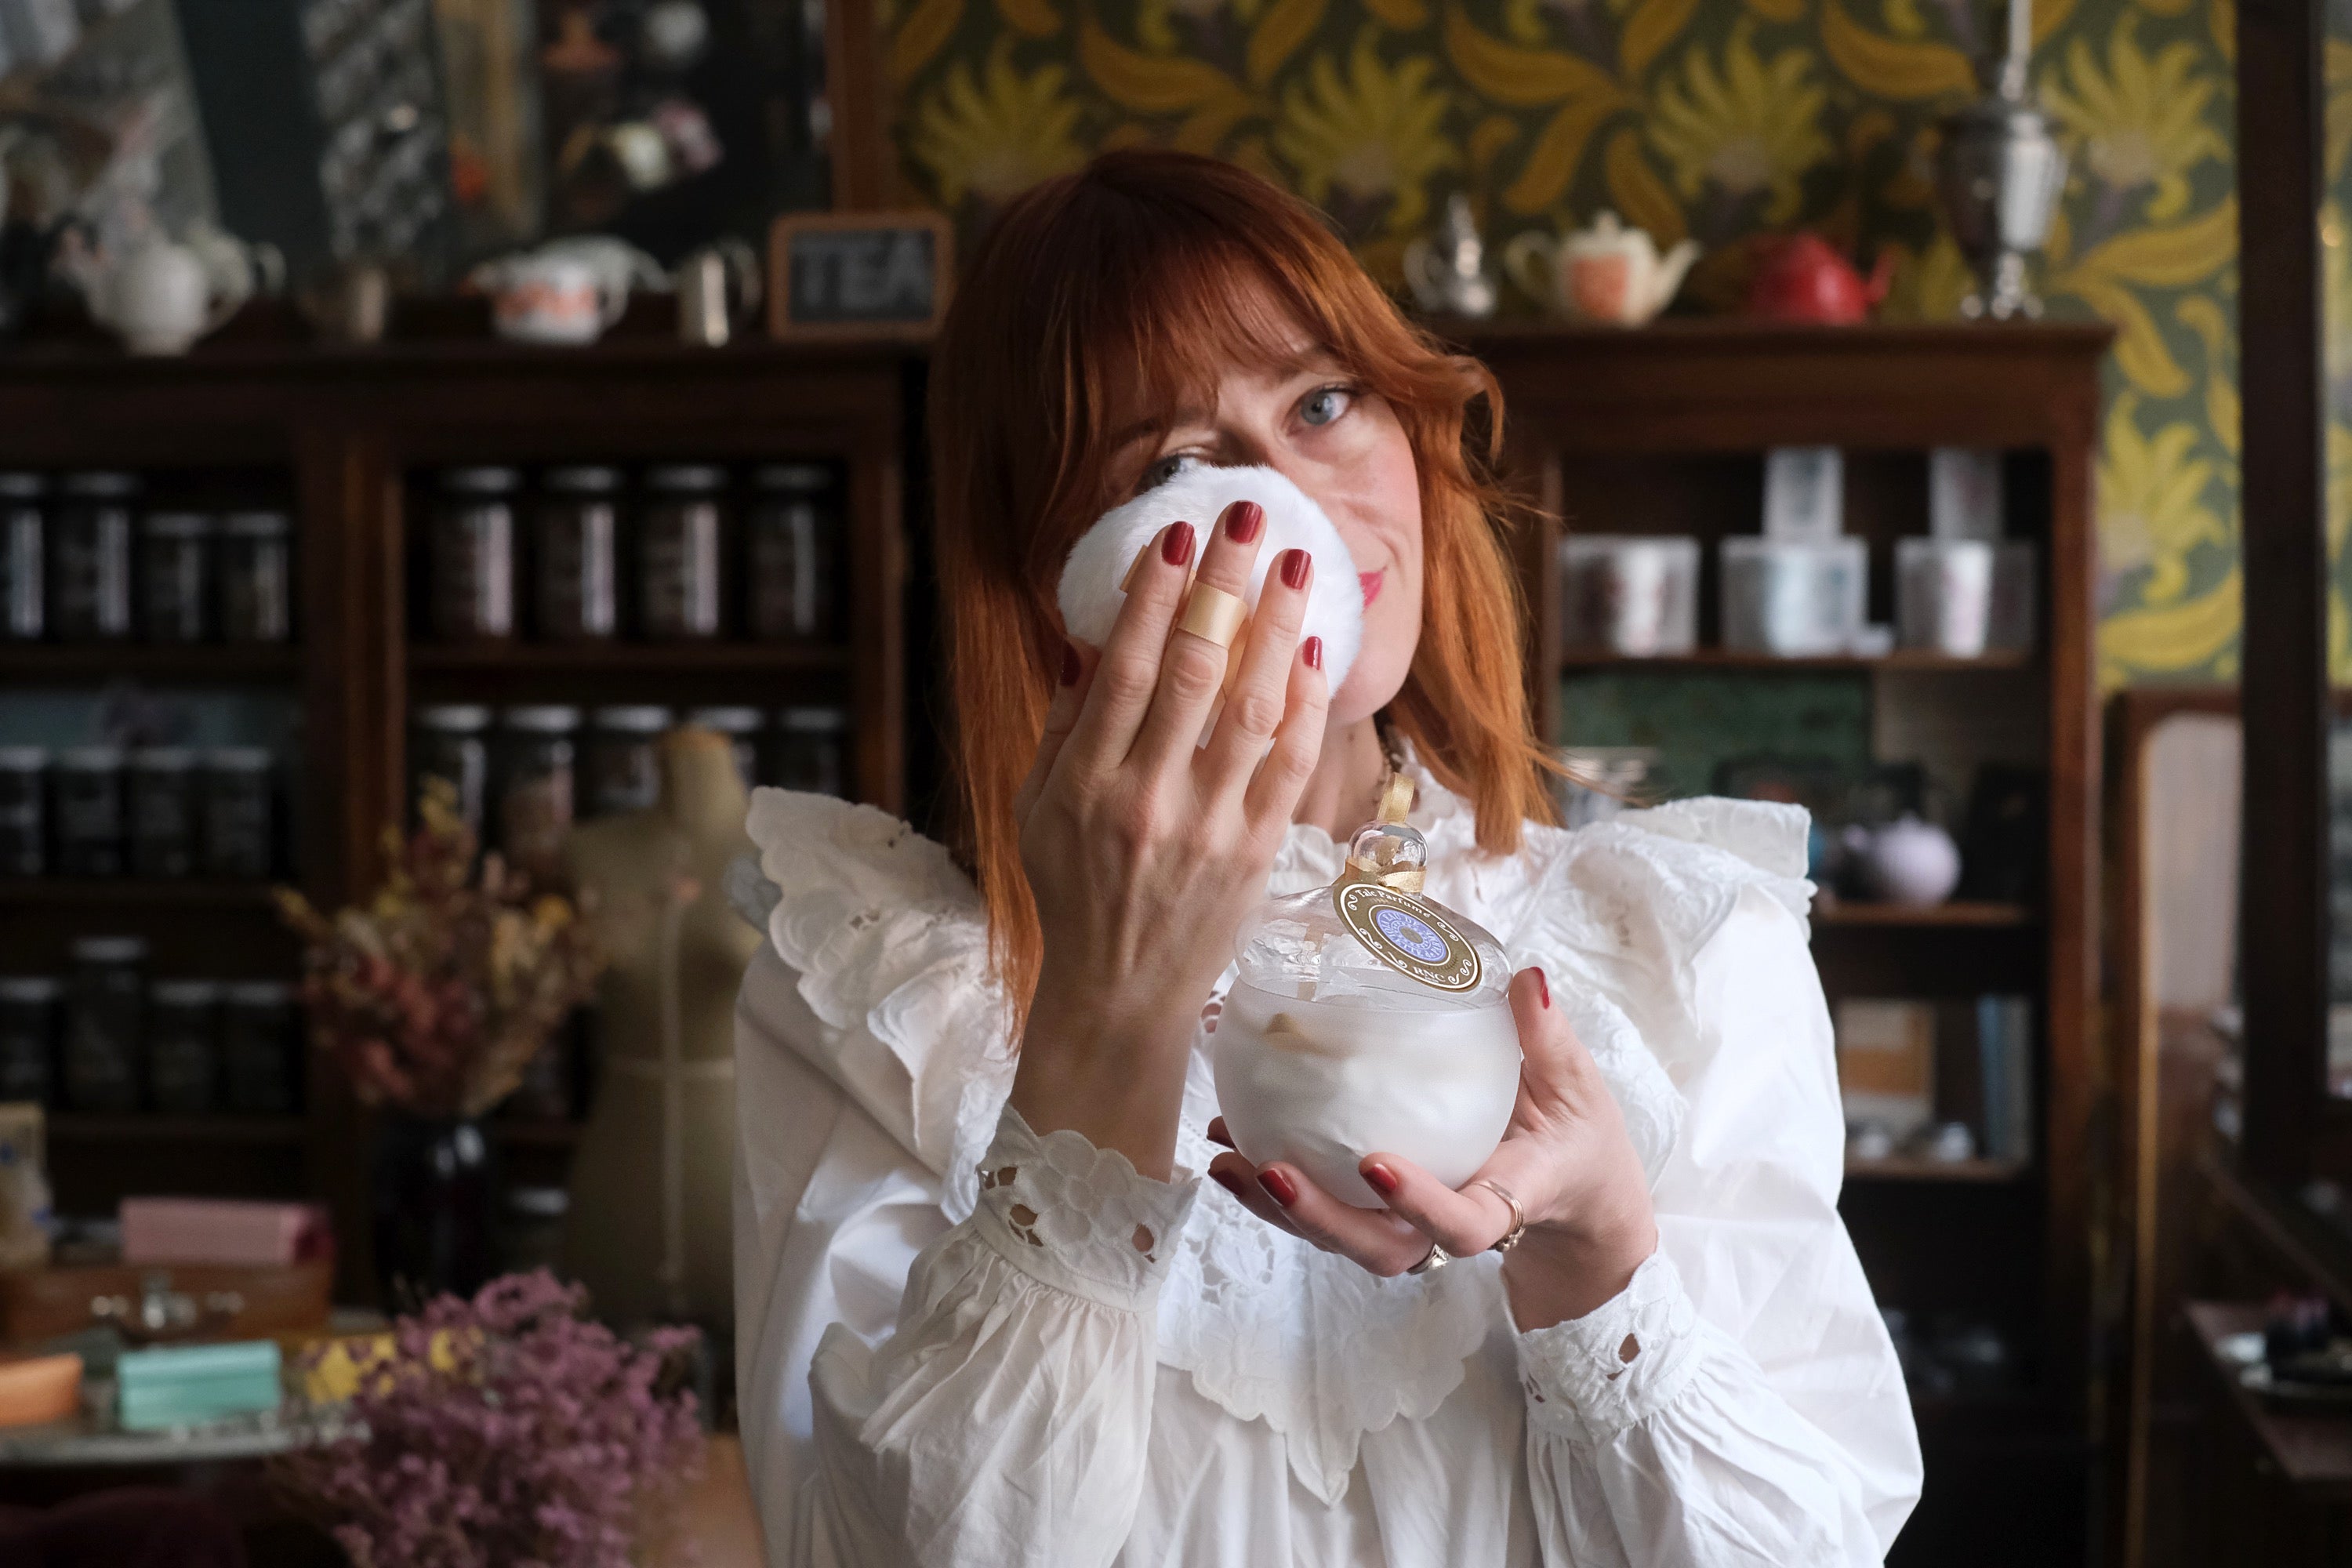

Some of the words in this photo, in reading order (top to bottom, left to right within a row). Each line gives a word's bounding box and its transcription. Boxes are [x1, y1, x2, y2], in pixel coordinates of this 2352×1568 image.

[790, 235, 932, 307] TEA
[1377, 890, 1431, 917] Parfumé
[1382, 913, 1402, 921] EAU
[1404, 916, 1418, 927] DE
[1413, 966, 1446, 982] RNC
